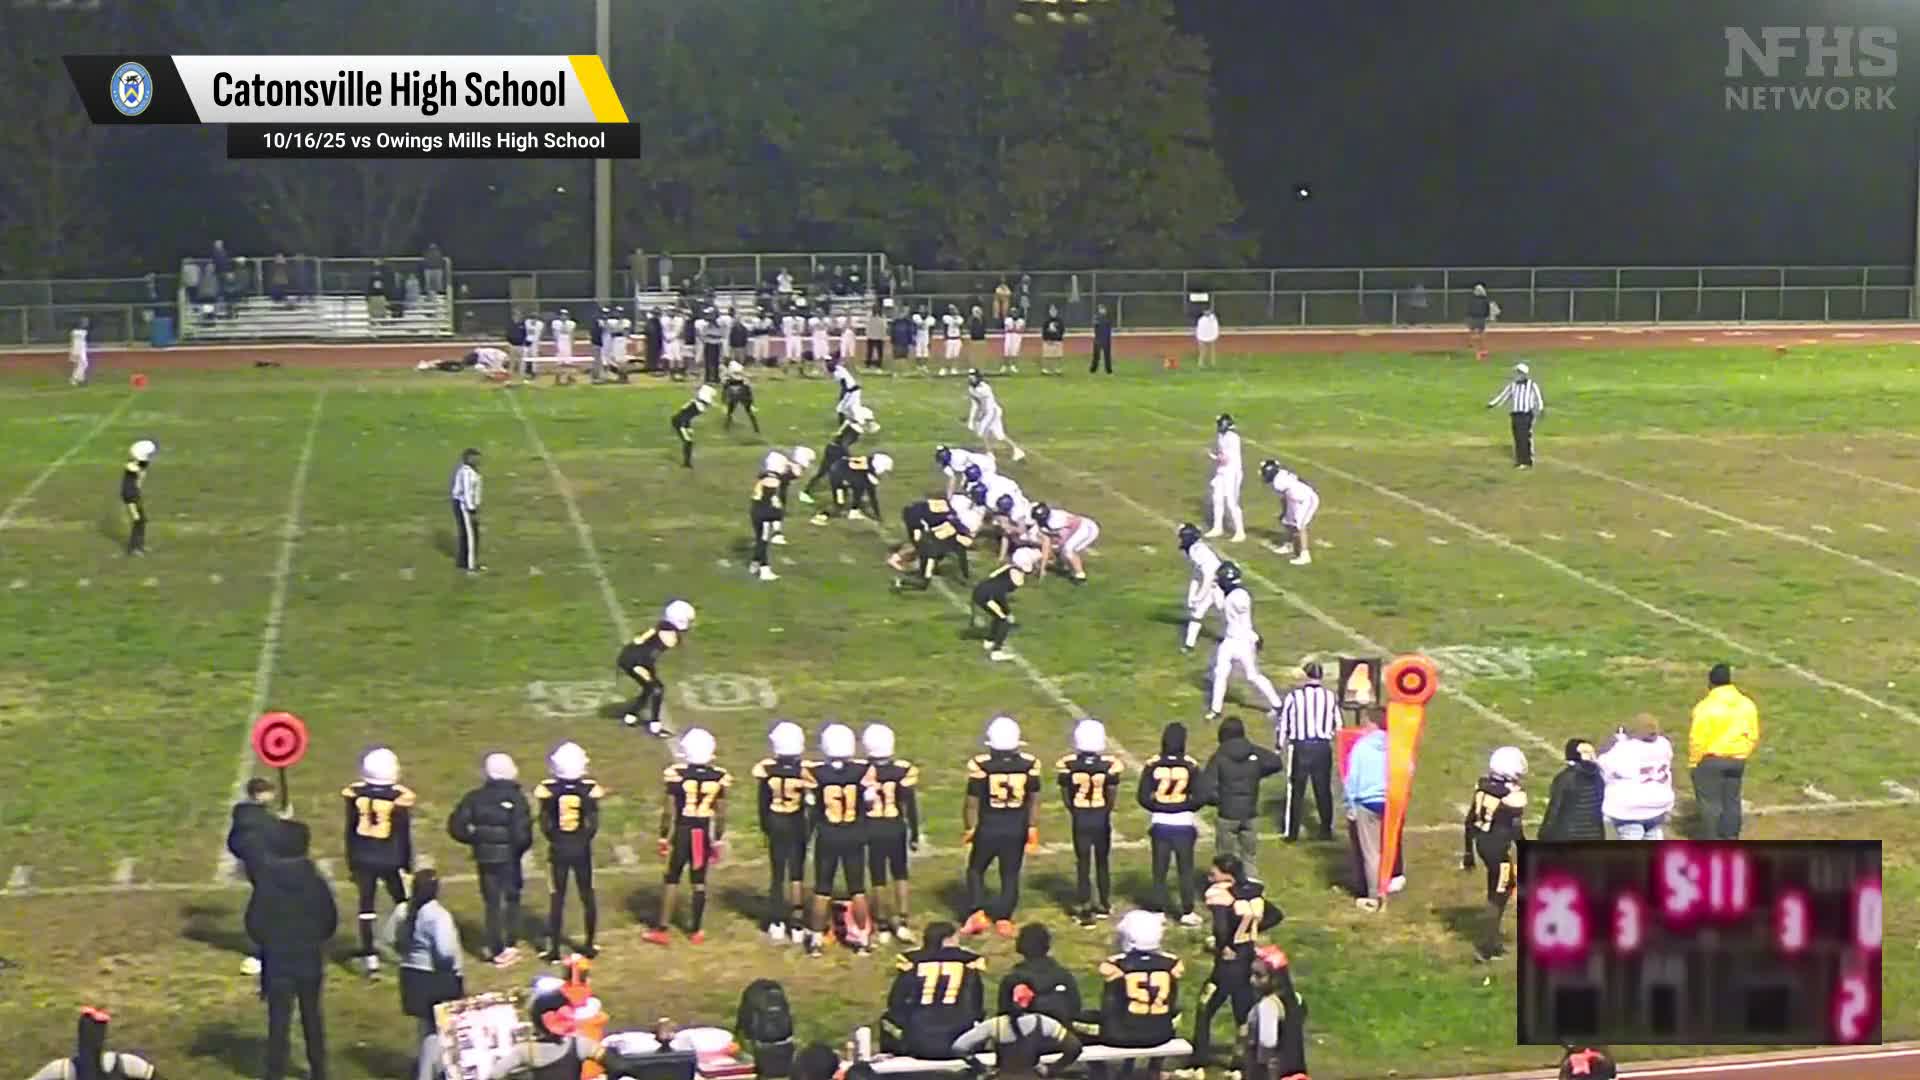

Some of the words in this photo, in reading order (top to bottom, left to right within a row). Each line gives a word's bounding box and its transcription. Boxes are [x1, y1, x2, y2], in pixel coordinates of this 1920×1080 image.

[1345, 662, 1377, 704] 4
[768, 776, 801, 813] 15
[989, 773, 1028, 808] 53
[1072, 773, 1106, 808] 21
[1153, 767, 1190, 804] 22
[1616, 895, 1641, 951] 3
[1780, 895, 1806, 951] 3
[917, 961, 965, 1005] 77
[1125, 971, 1171, 1014] 52
